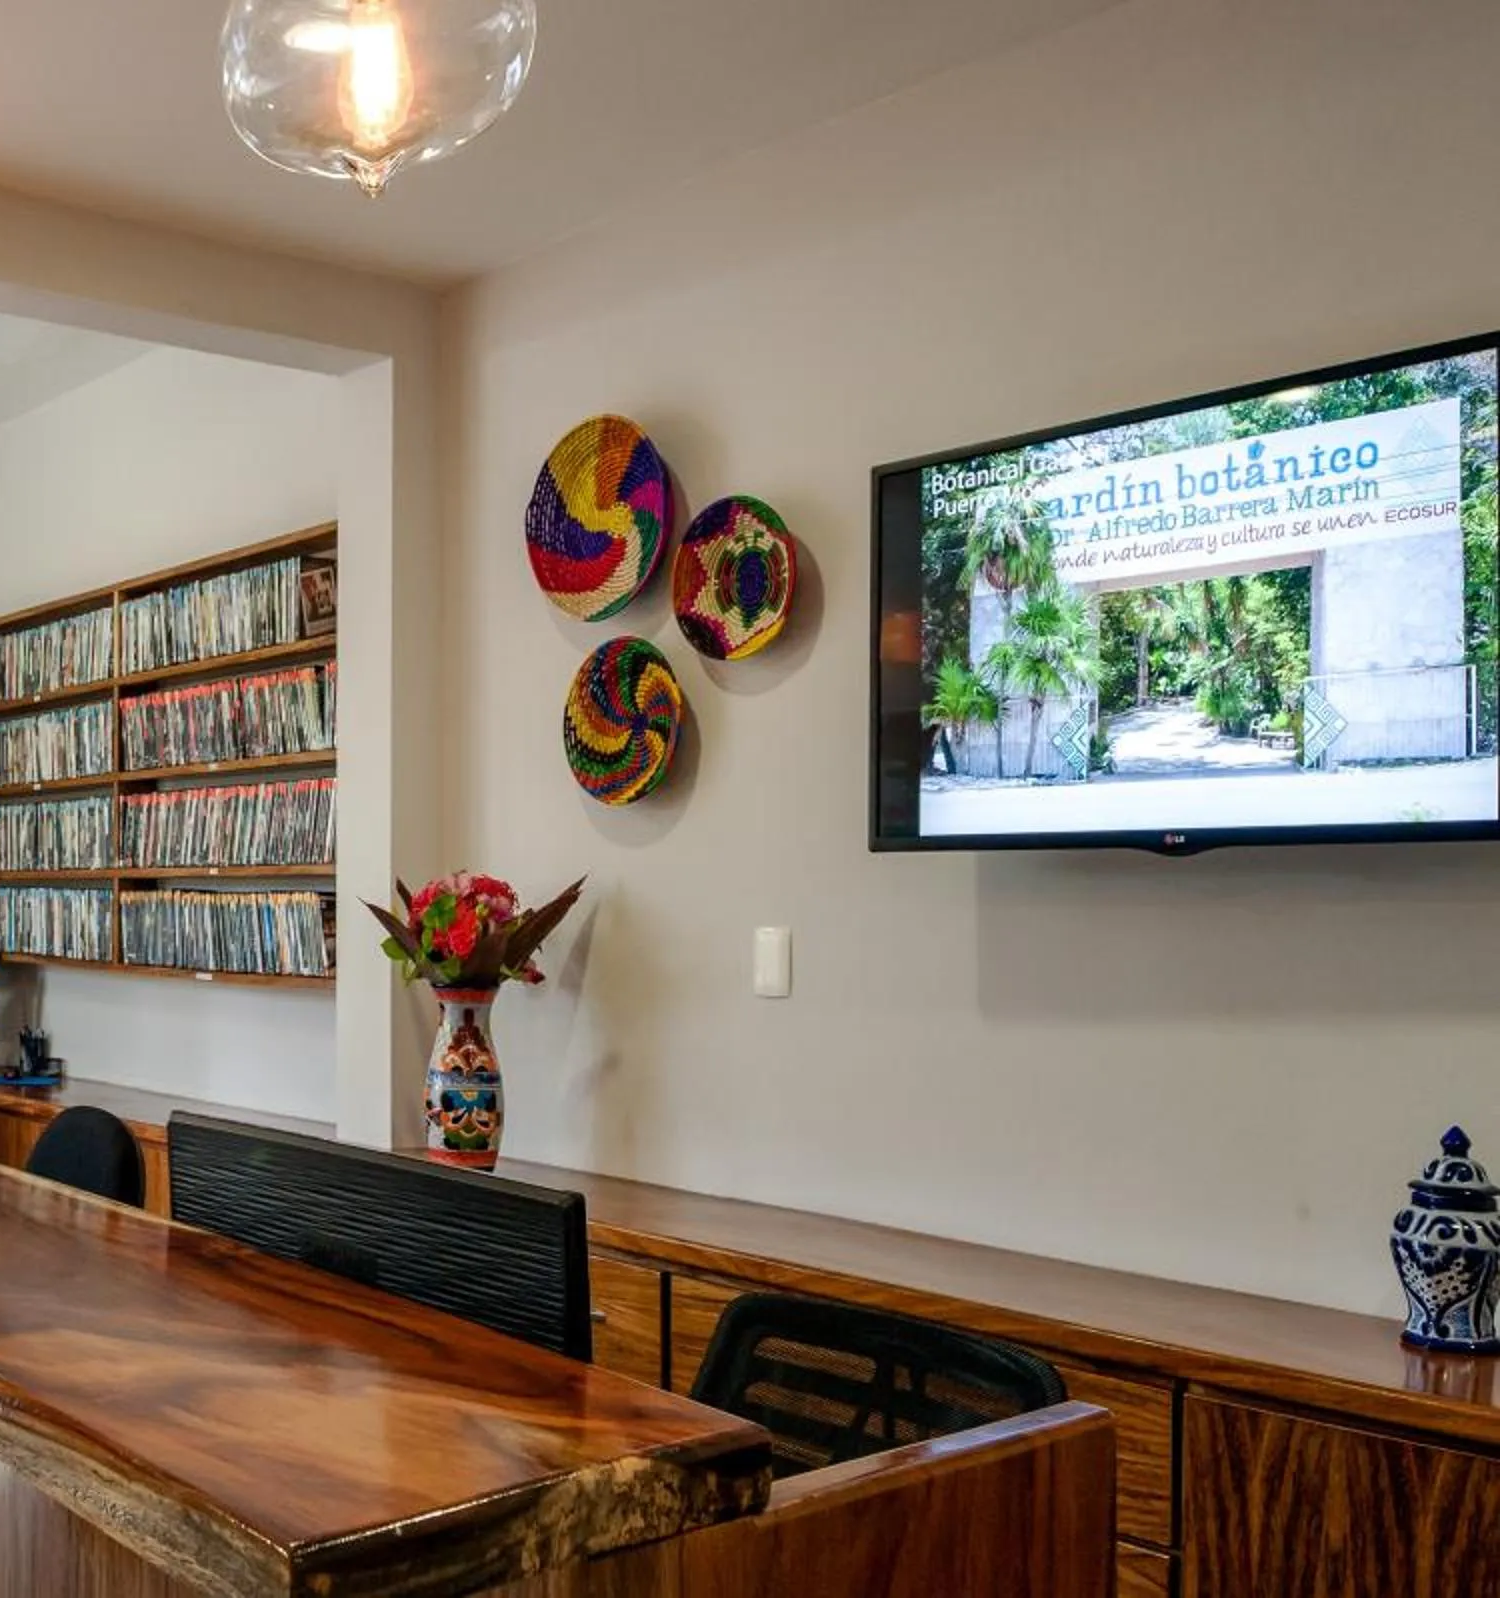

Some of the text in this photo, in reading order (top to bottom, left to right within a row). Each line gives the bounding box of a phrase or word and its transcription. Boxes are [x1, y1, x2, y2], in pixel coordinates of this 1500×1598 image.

[931, 458, 1024, 495] Botanical
[1047, 474, 1162, 521] ardín
[1085, 509, 1177, 543] Alfredo
[1181, 495, 1278, 530] Barrera
[1286, 475, 1380, 512] Marín
[1103, 535, 1205, 565] naturaleza
[1206, 533, 1218, 554] y
[1221, 520, 1286, 547] cultura
[1292, 519, 1313, 537] se
[1317, 510, 1377, 531] unen
[1384, 501, 1458, 524] ECOSUR
